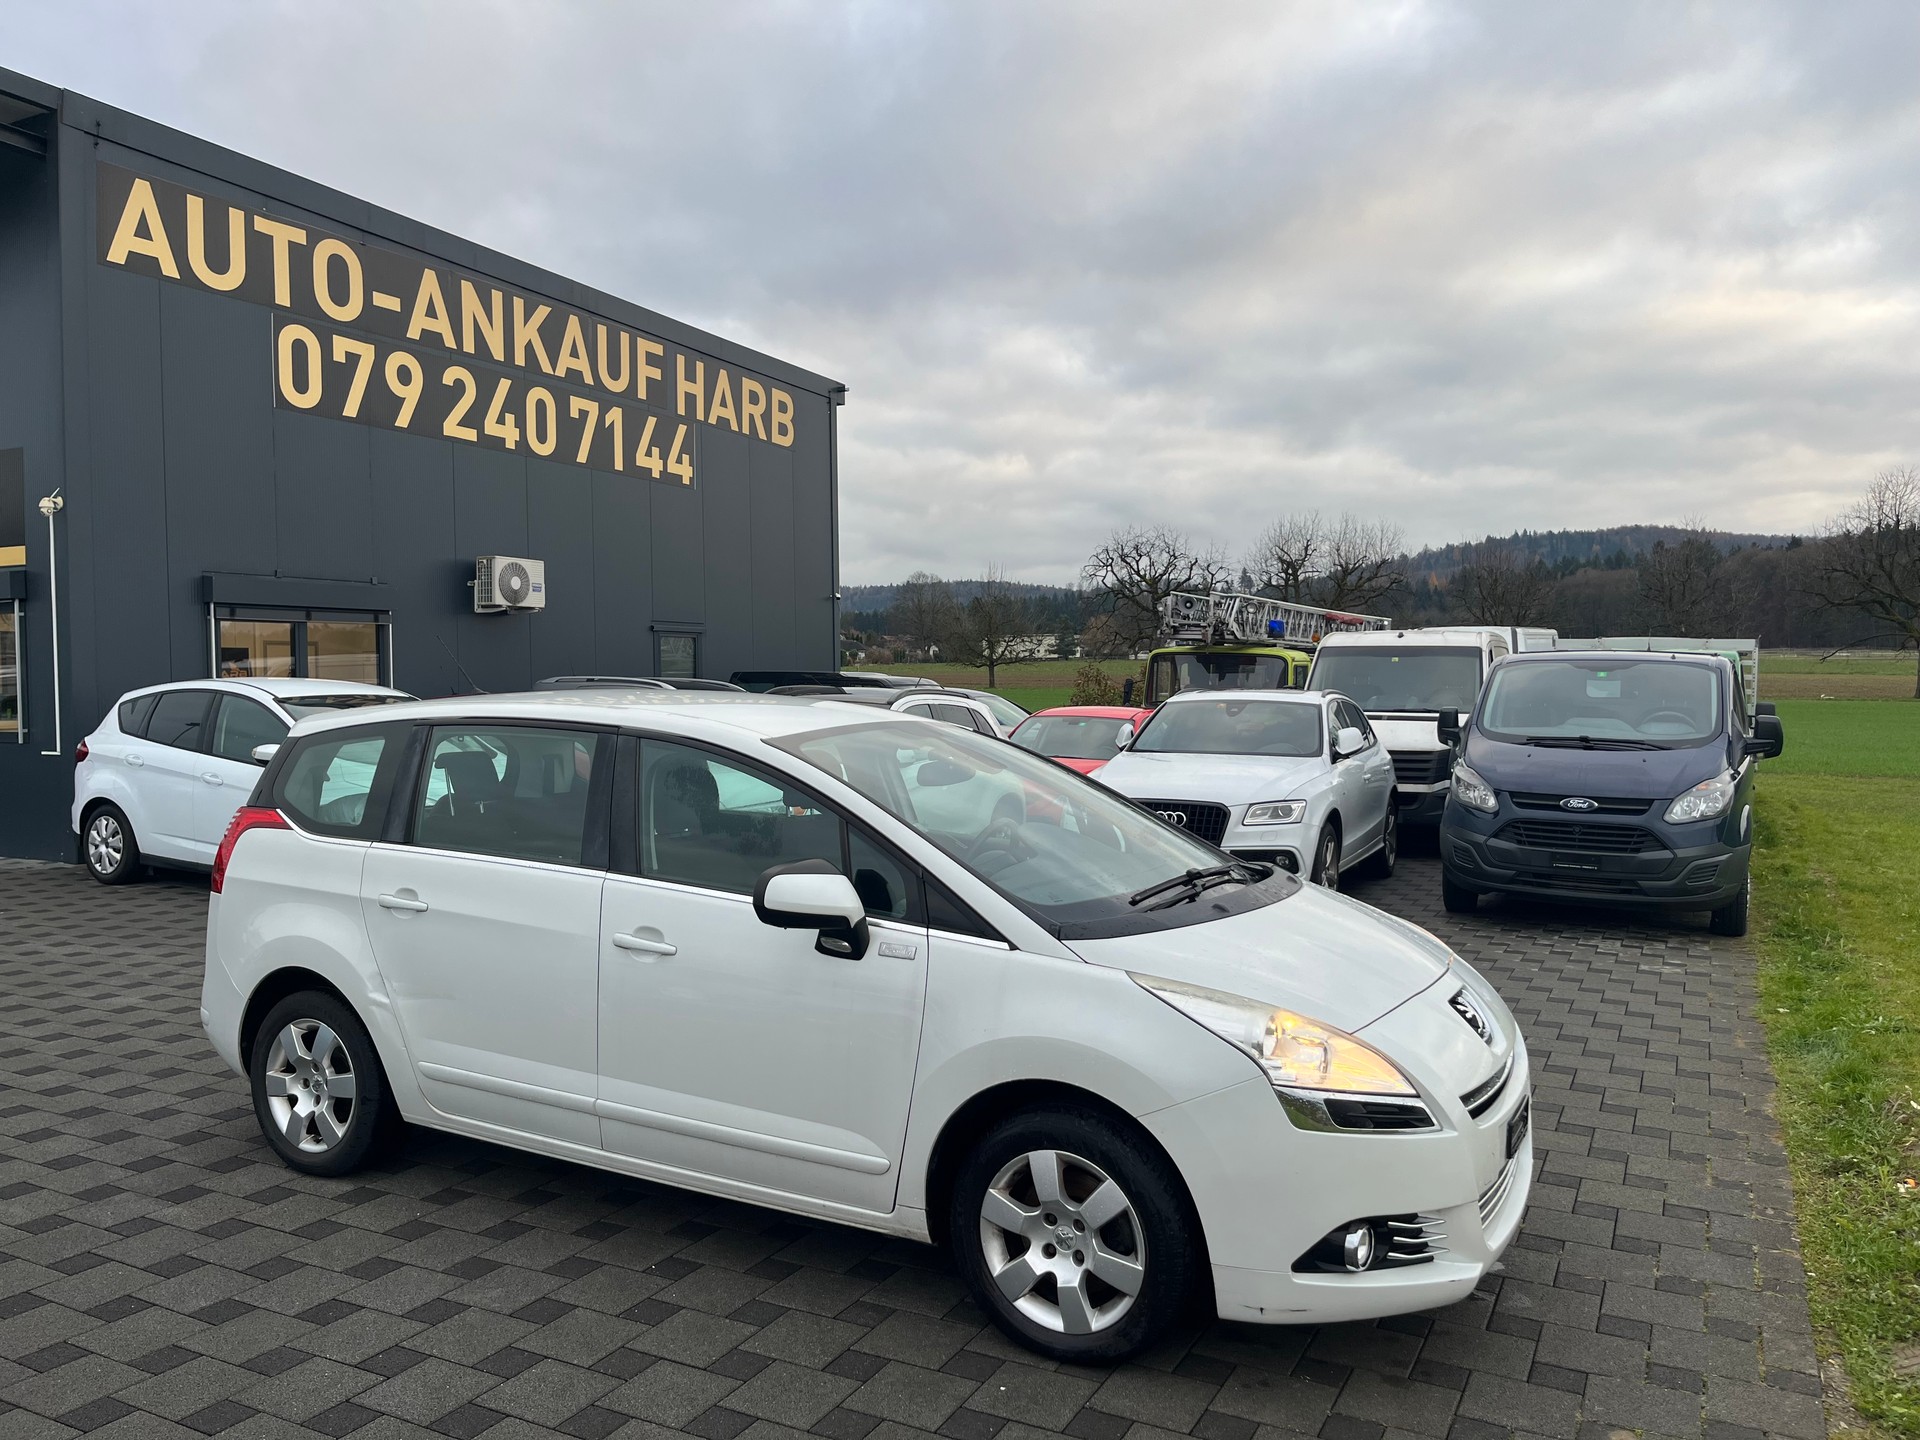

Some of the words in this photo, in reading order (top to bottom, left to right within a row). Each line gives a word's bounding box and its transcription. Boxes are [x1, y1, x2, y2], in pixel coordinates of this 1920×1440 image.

[107, 178, 664, 400] AUTO-ANKAUF
[677, 354, 796, 448] HARB
[277, 323, 424, 429] 079
[442, 364, 557, 456] 240
